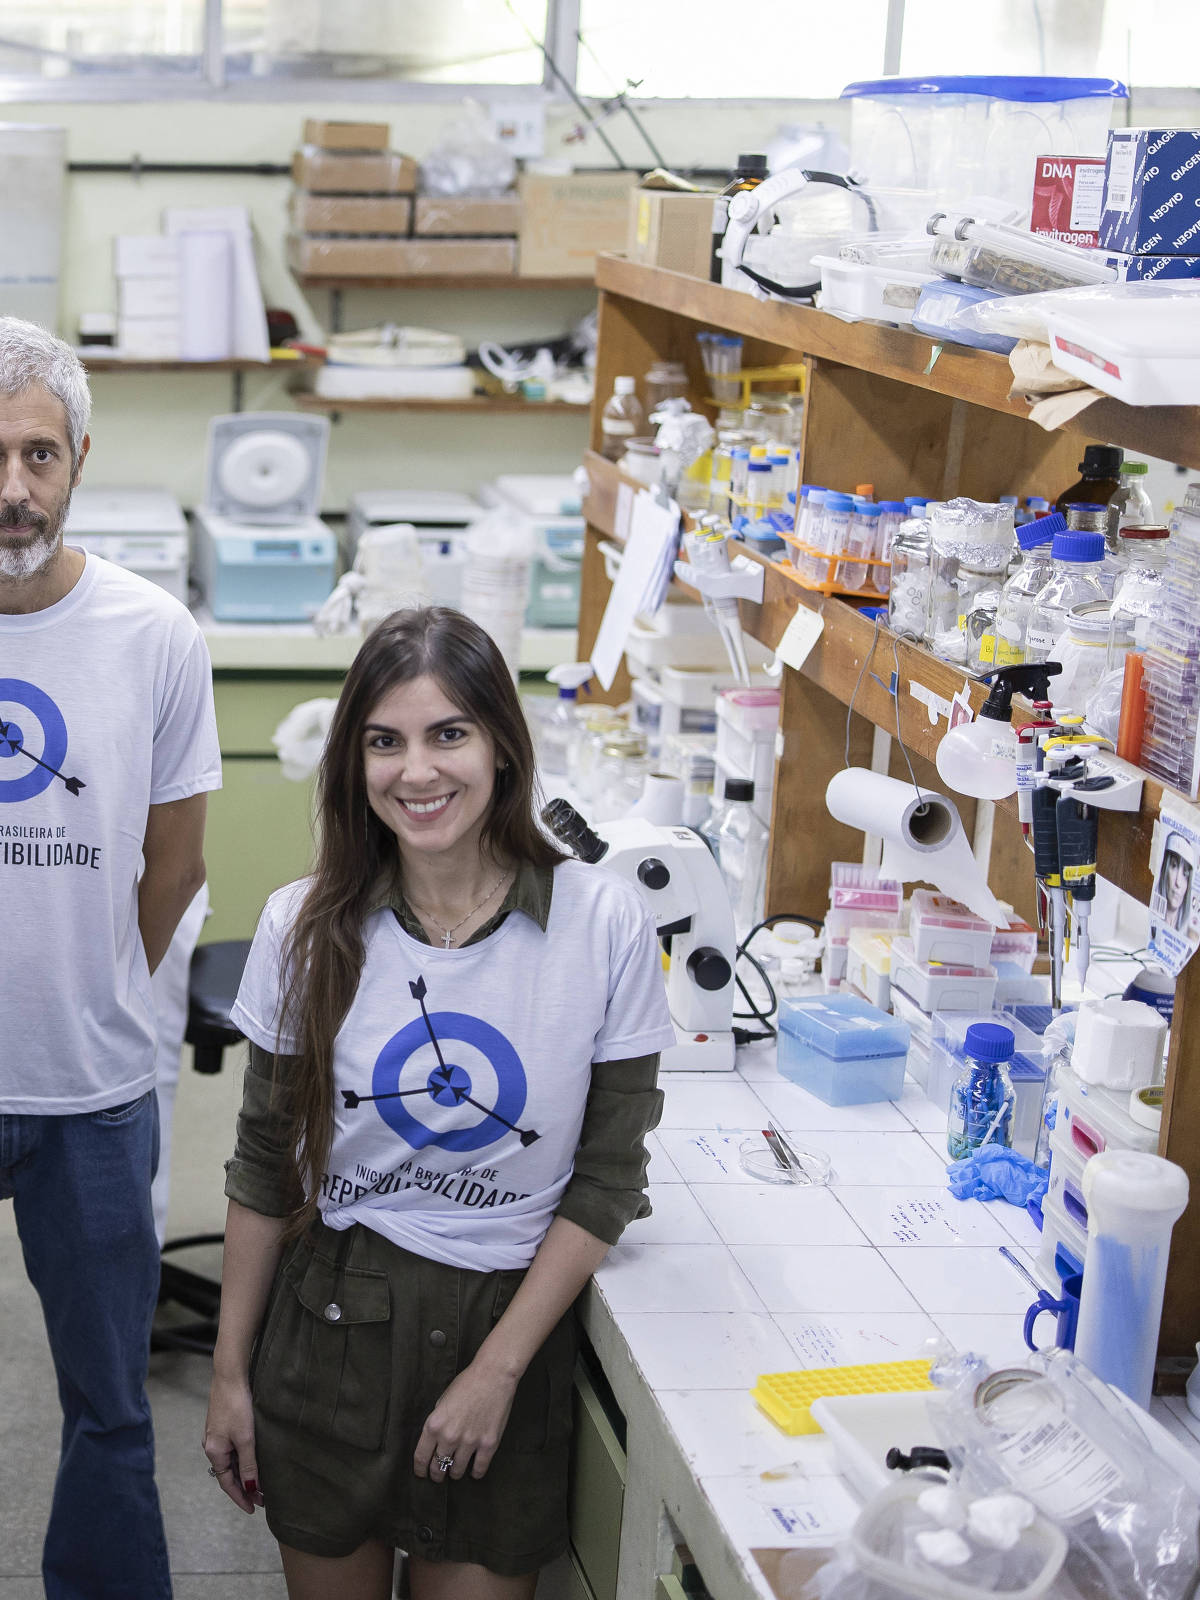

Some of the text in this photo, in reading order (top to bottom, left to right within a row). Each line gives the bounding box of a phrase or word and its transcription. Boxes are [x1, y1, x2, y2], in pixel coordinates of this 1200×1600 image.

[1042, 162, 1073, 179] DNA
[1149, 192, 1184, 223] QIAGEN
[1136, 233, 1163, 254] AGEN
[56, 826, 66, 838] DE
[481, 1167, 499, 1182] DE
